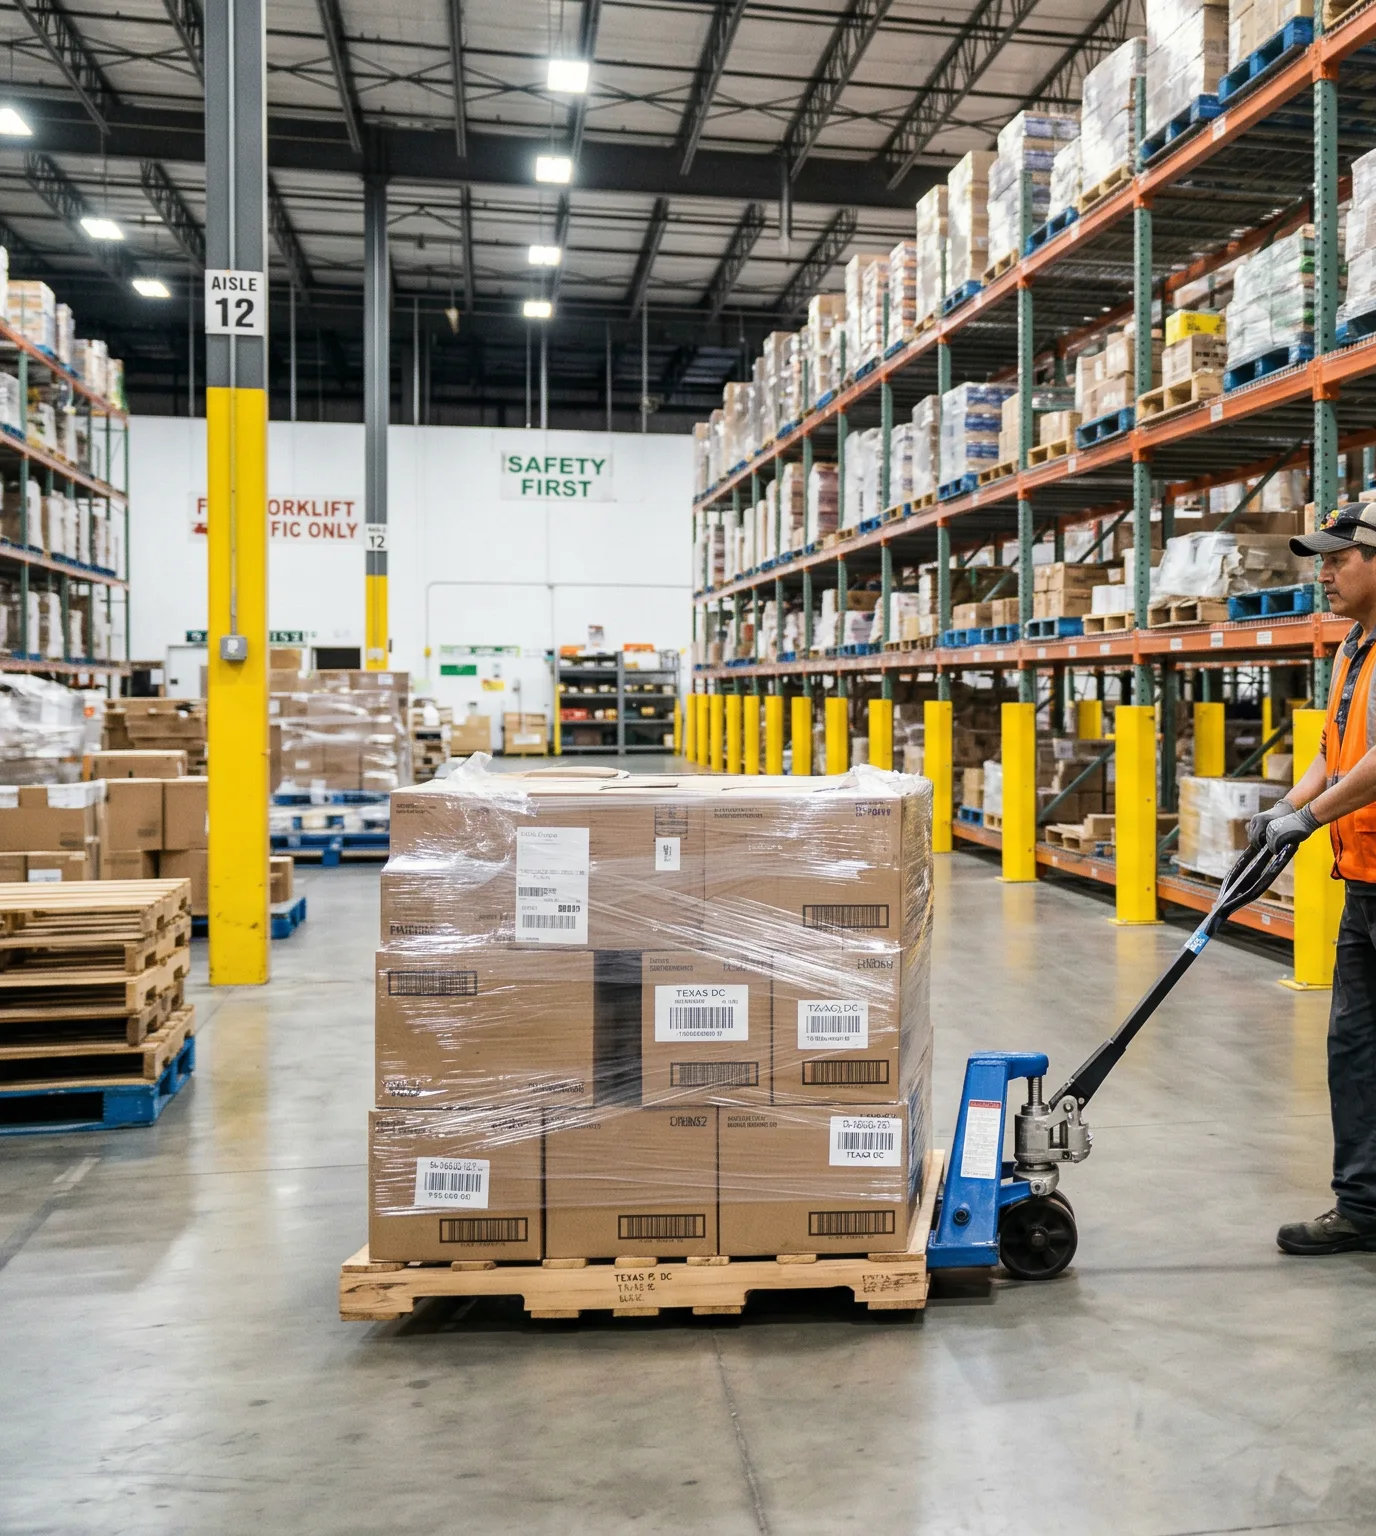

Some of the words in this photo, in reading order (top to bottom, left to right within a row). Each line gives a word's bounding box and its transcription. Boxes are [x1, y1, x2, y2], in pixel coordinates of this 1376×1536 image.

[211, 276, 257, 291] AISLE
[215, 297, 254, 328] 12
[508, 456, 606, 475] SAFETY
[521, 479, 593, 497] FIRST
[268, 499, 355, 517] ORKLIFT
[308, 522, 358, 538] ONLY
[369, 535, 385, 548] 12
[676, 989, 709, 998] TEXAS
[711, 989, 726, 997] DC
[614, 1273, 645, 1282] TEXAS
[660, 1272, 673, 1281] DC
